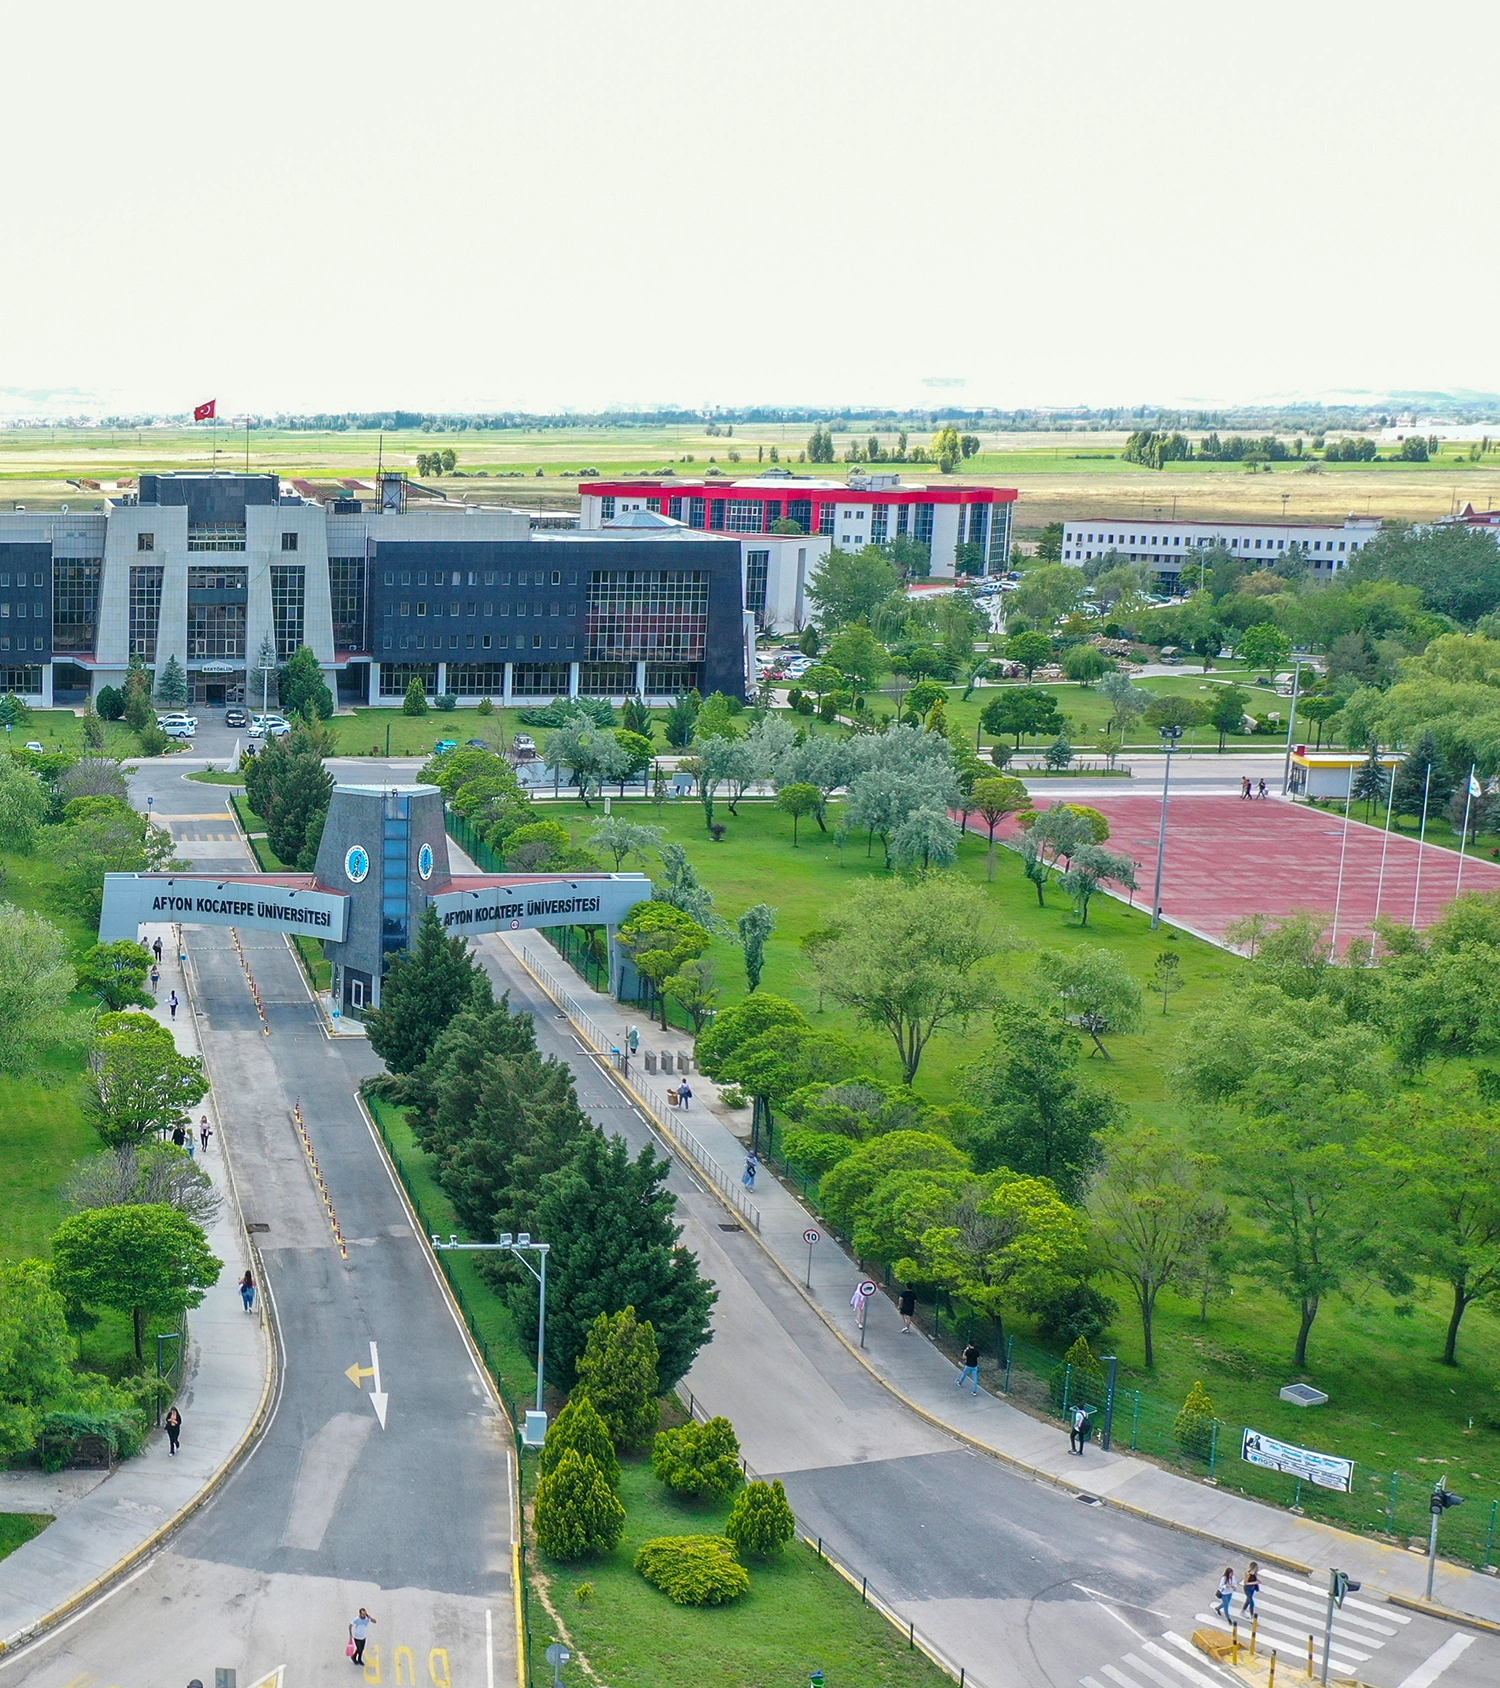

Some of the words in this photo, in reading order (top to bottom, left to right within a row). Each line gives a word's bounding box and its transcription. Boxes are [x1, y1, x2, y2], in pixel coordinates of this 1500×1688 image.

[152, 896, 193, 912] AFYON
[196, 898, 254, 917] KOCATEPE
[257, 901, 331, 927] ÜNİVERSİTESİ
[443, 909, 473, 927] AFYON
[475, 903, 524, 922] KOCATEPE
[527, 895, 601, 916] ÜNİVERSİTESİ
[805, 1233, 817, 1241] 10
[362, 1645, 452, 1688] DUR
